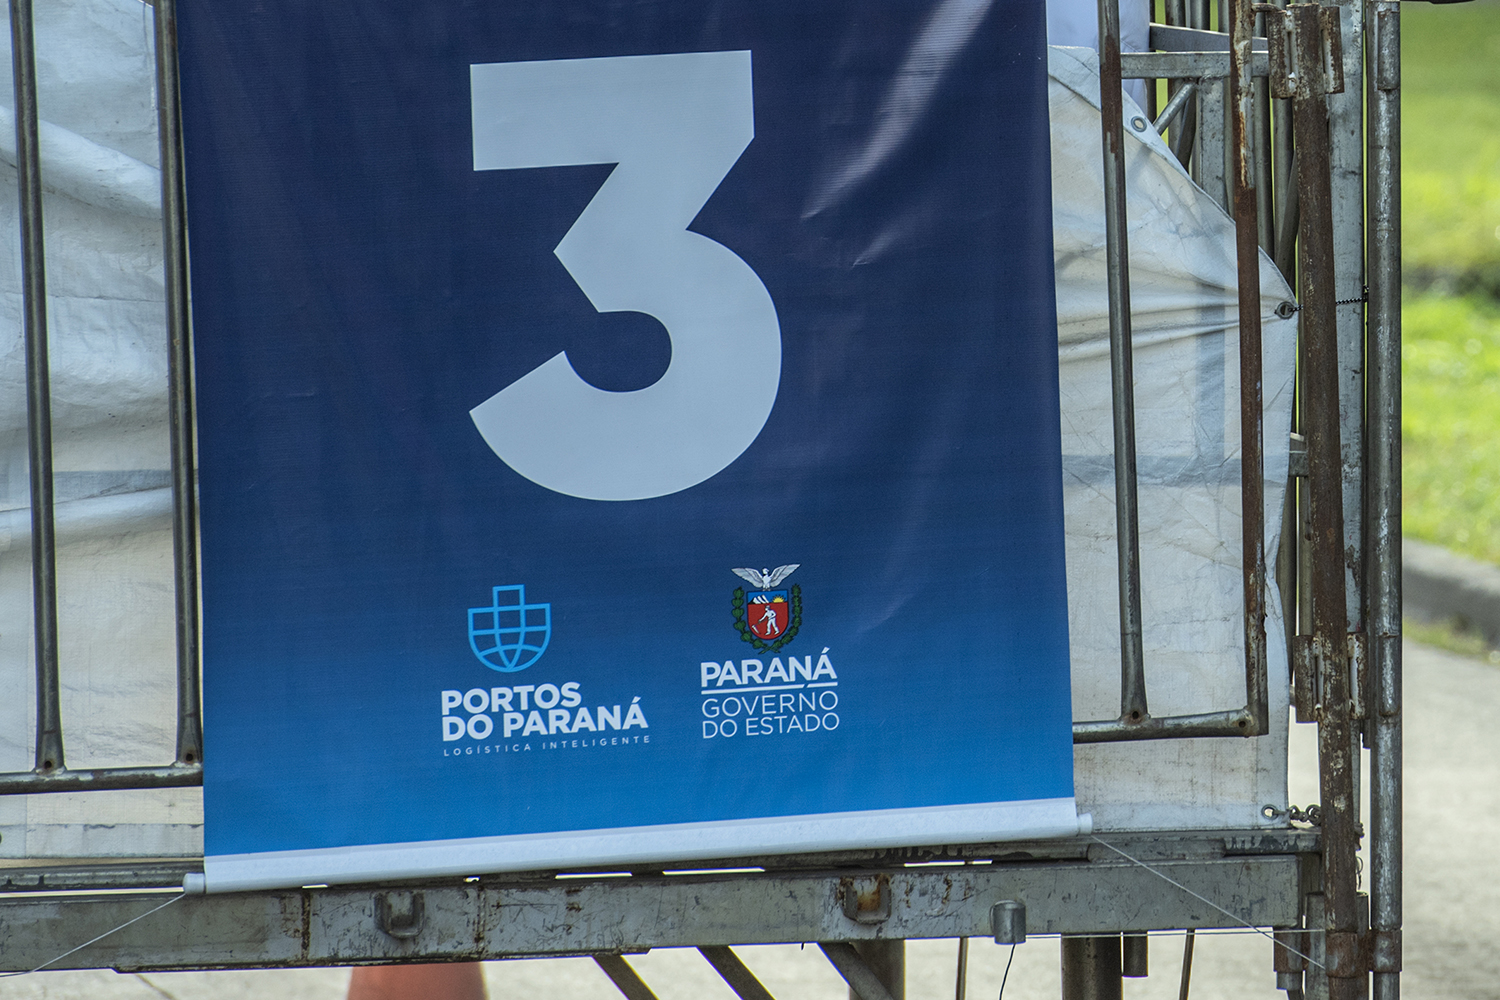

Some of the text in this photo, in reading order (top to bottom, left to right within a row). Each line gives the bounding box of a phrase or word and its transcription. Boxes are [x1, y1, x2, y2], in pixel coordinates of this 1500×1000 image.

[469, 49, 782, 501] 3
[701, 646, 838, 688] PARANÁ
[441, 681, 582, 716] PORTOS
[702, 690, 839, 718] GOVERNO
[442, 696, 649, 742] DO PARANÁ
[702, 712, 840, 739] DO ESTADO
[443, 735, 651, 757] LOGÍSTICA INTELIGENTE
